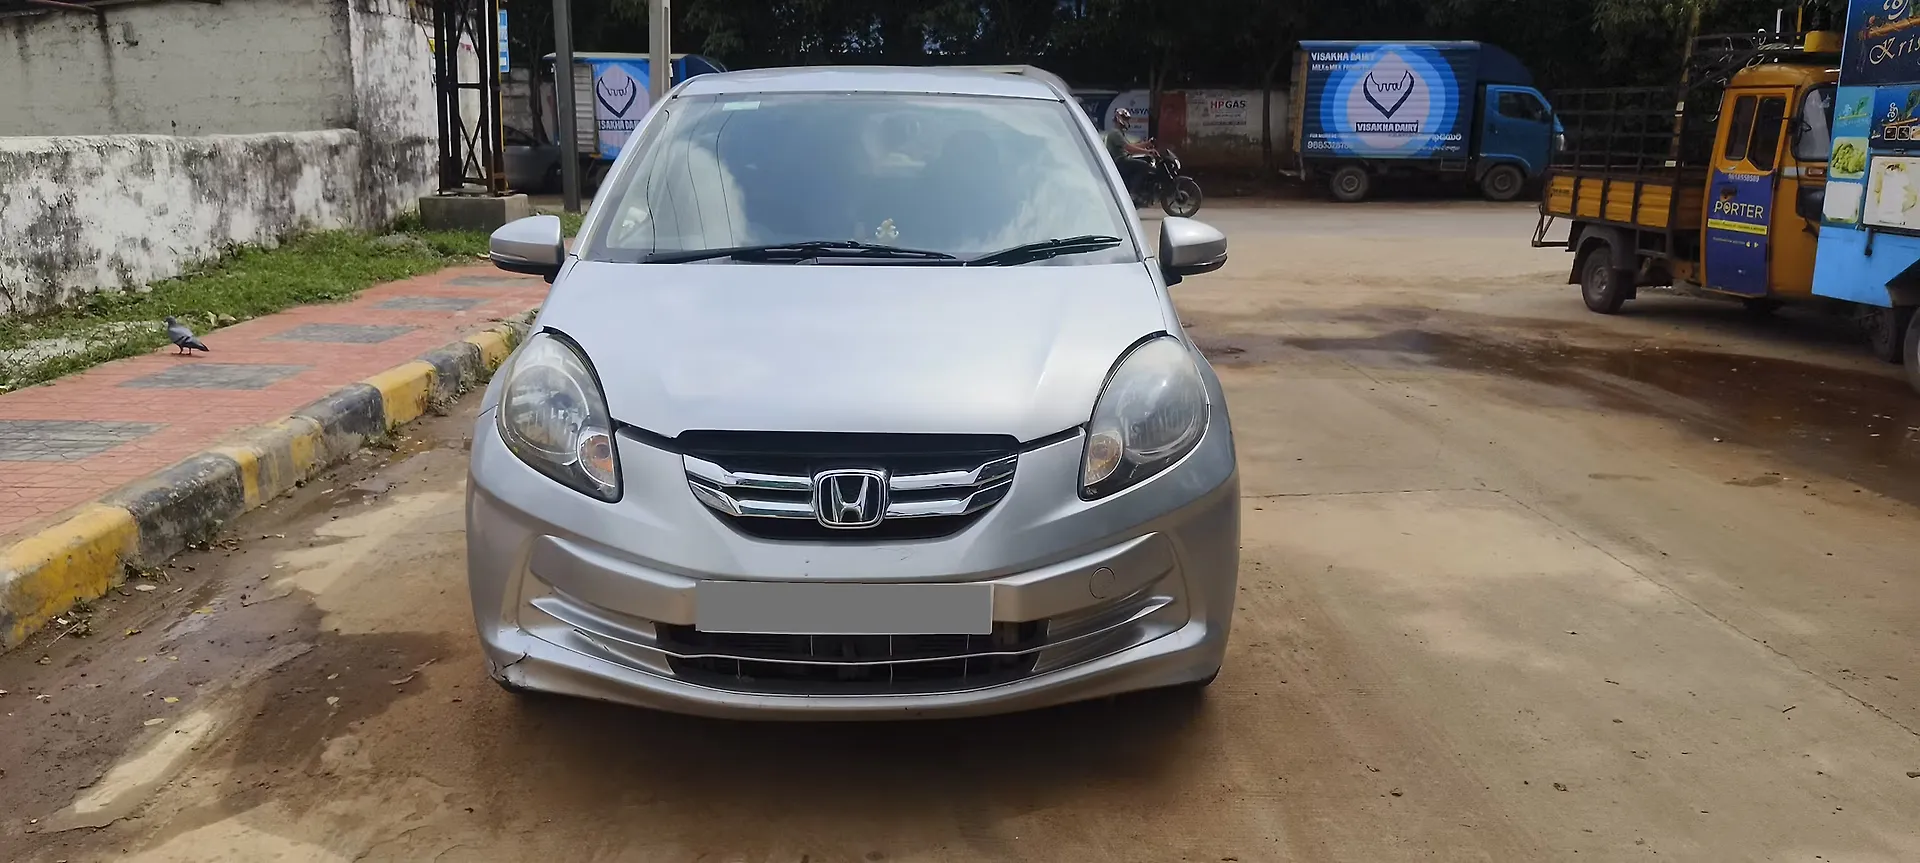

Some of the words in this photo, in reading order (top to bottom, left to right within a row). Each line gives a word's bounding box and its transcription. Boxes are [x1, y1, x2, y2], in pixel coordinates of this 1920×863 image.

[1311, 52, 1349, 61] VISAKHA
[598, 120, 625, 129] ISAKHA
[1357, 123, 1395, 132] VISAKHA
[1395, 123, 1418, 132] DAIRY
[1714, 200, 1764, 218] PORTER
